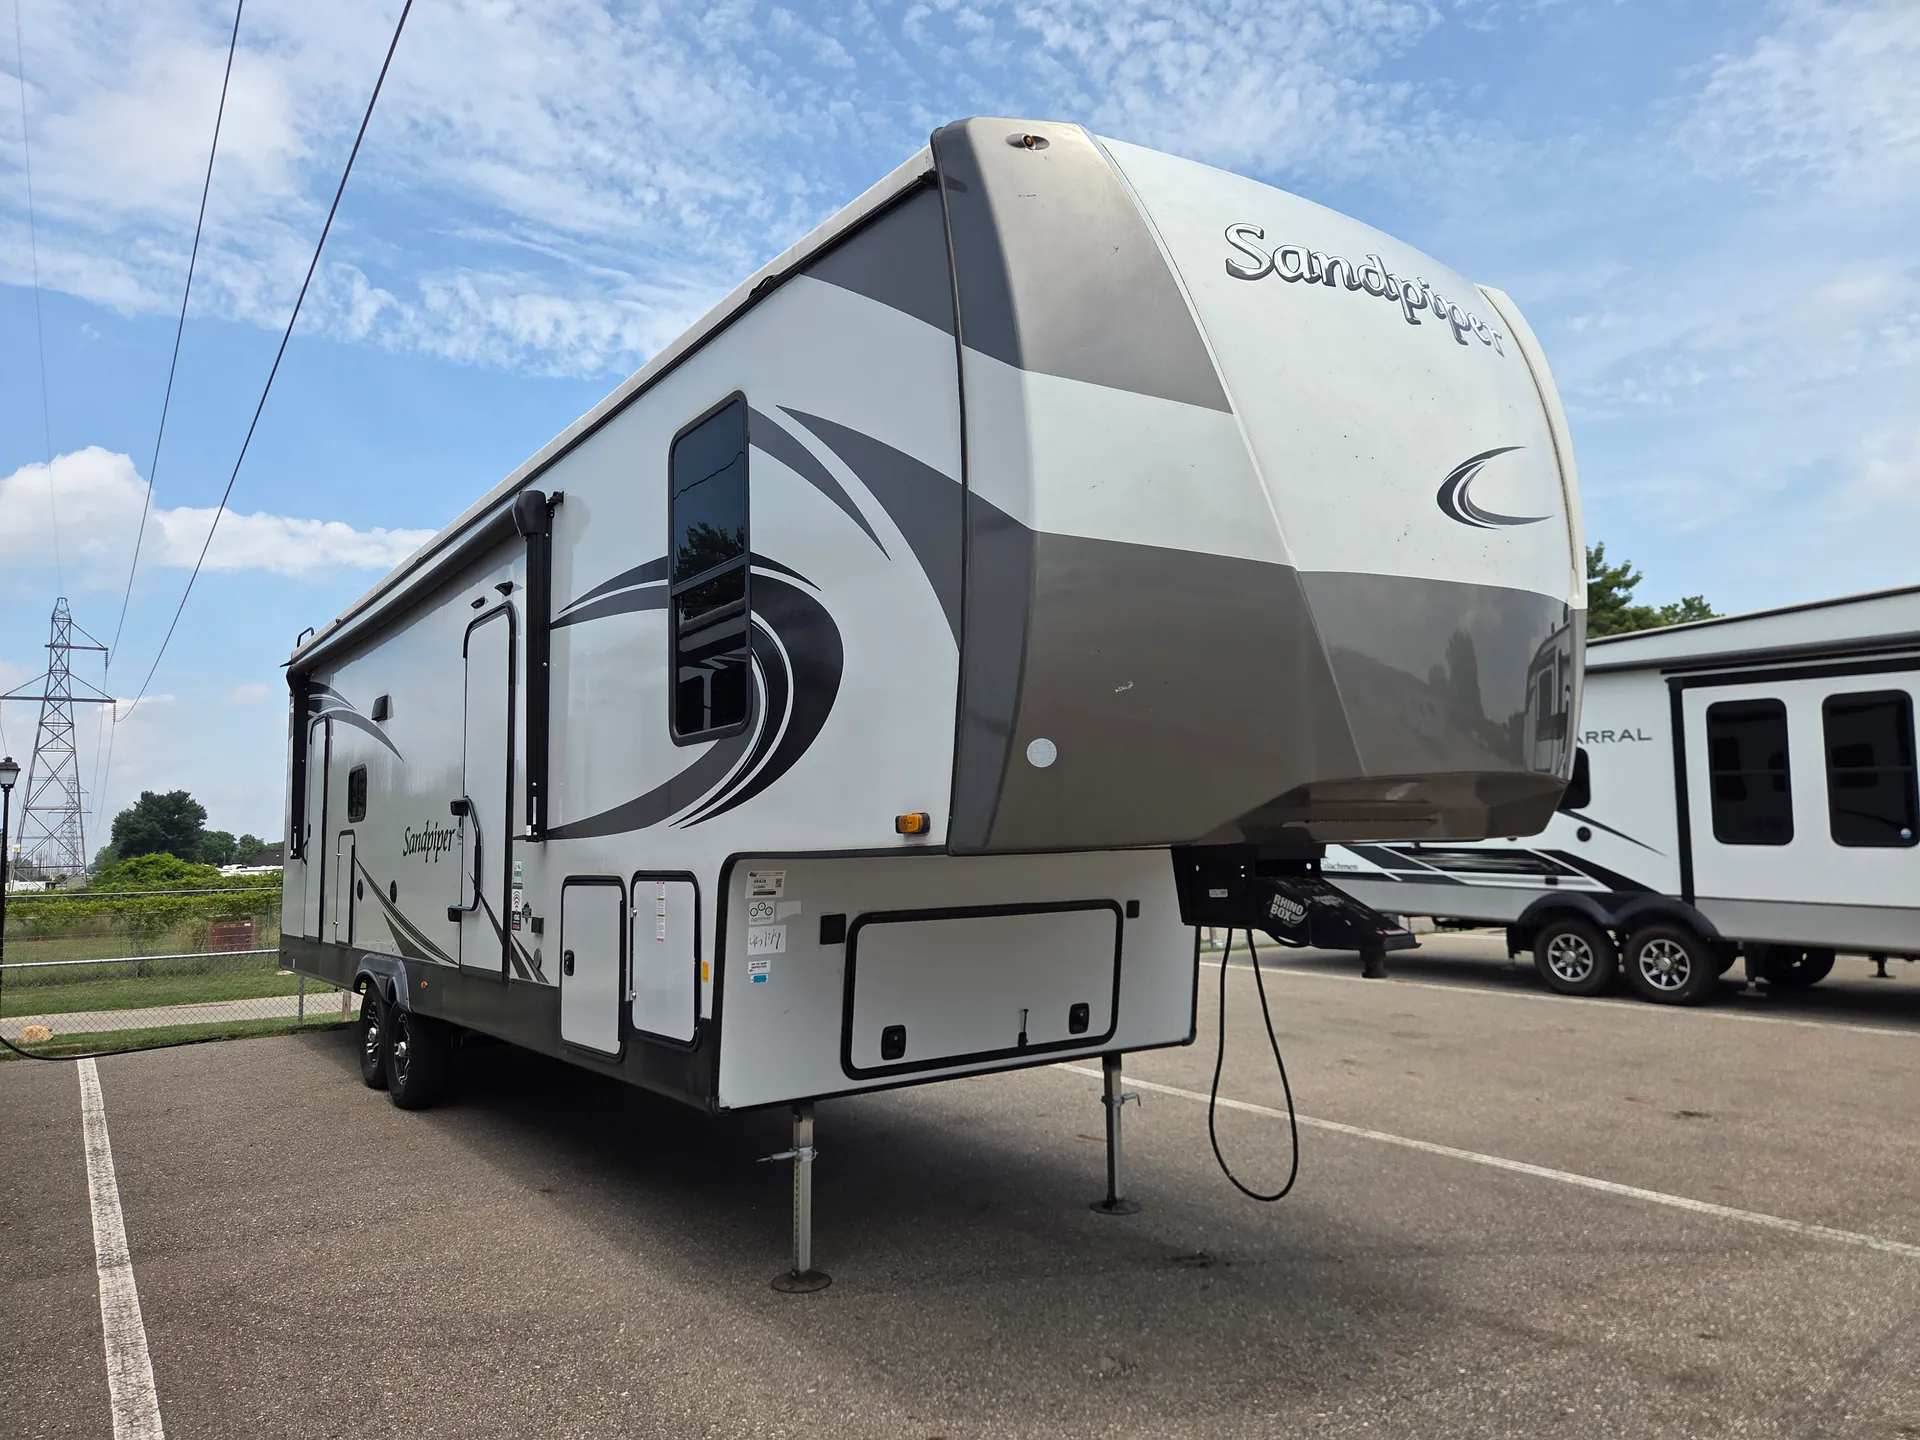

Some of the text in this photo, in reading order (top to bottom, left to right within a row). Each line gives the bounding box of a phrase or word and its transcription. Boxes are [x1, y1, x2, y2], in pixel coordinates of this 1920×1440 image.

[1225, 222, 1505, 358] Sandpiper
[1577, 728, 1652, 745] RRAL
[403, 819, 456, 863] Sandpiper
[1270, 903, 1292, 922] BOX
[1273, 893, 1304, 916] RHINO
